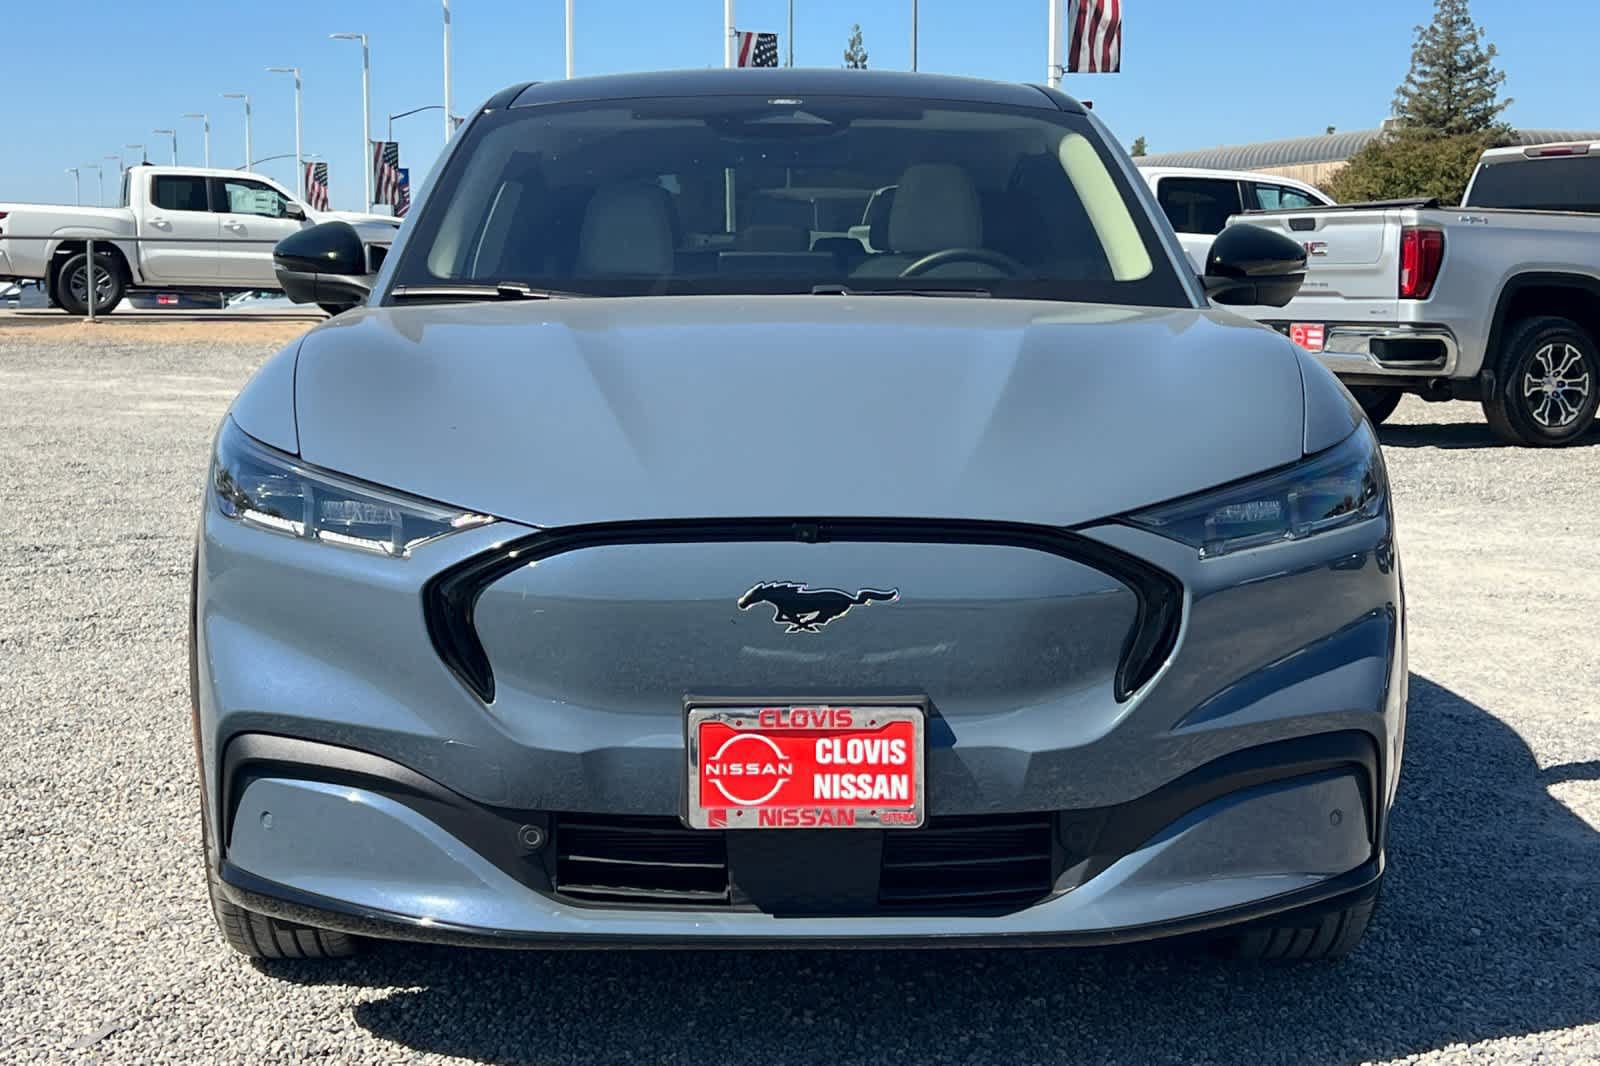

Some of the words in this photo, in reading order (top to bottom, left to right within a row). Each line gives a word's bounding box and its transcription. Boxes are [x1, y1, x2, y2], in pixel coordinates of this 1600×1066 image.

[758, 709, 853, 728] CLOVIS
[815, 738, 907, 765] CLOVIS
[705, 763, 793, 775] NISSAN
[813, 774, 908, 800] NISSAN
[758, 808, 856, 827] NISSAN
